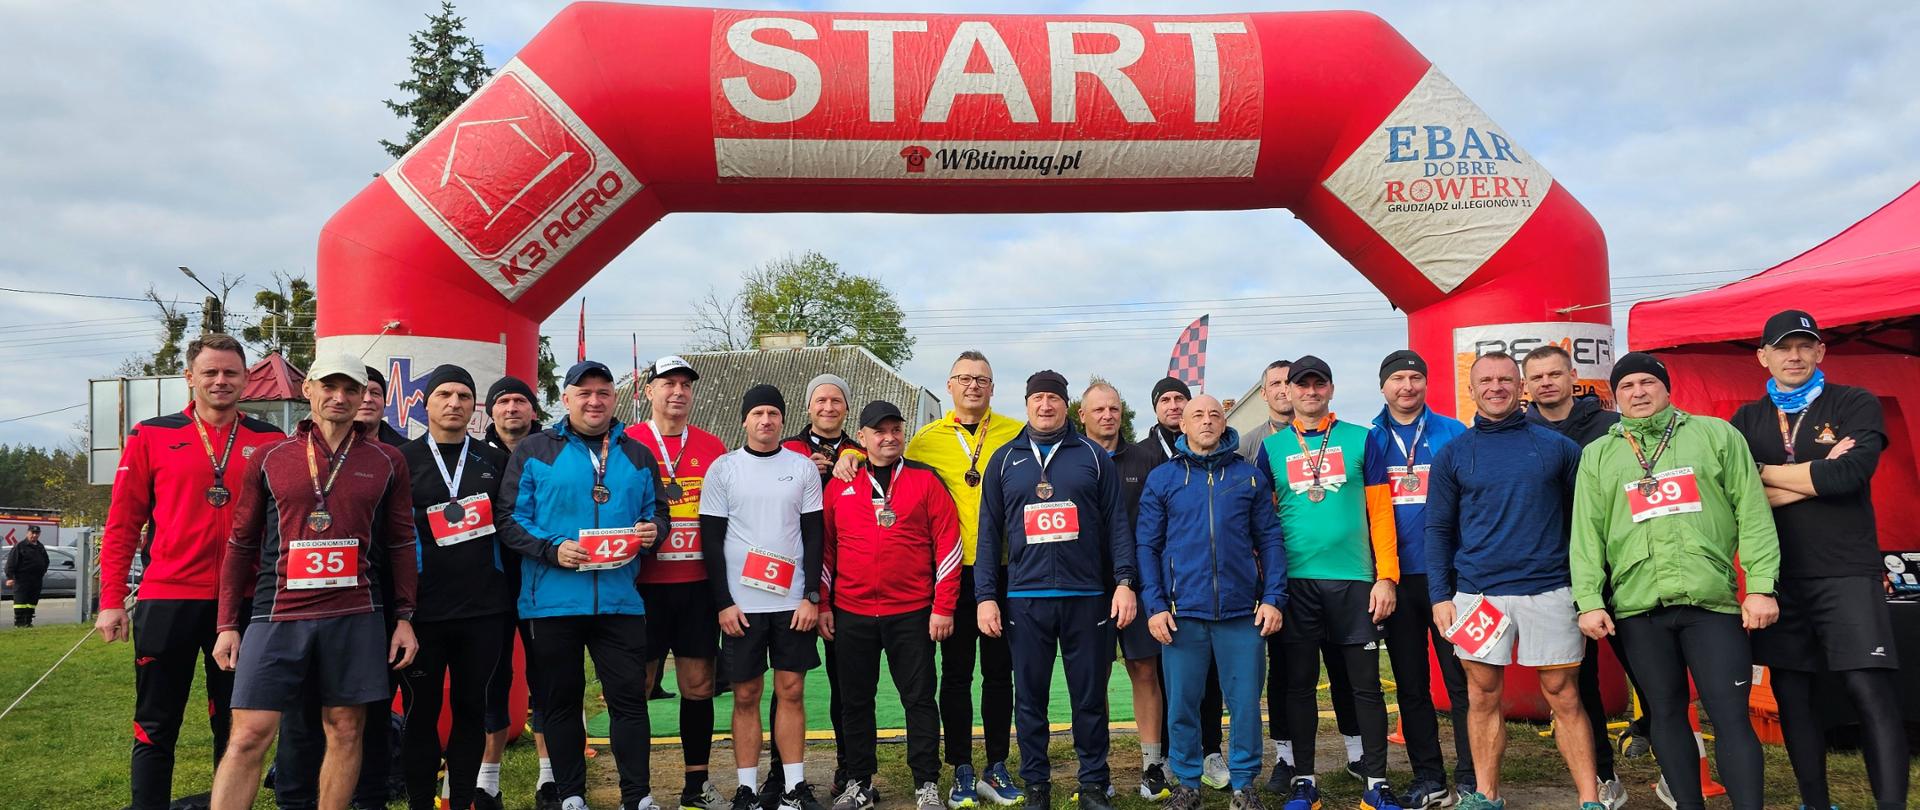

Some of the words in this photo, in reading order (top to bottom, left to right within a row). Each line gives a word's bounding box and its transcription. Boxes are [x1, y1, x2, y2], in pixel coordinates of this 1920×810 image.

[721, 18, 1247, 124] START
[1385, 125, 1522, 164] EBAR
[935, 148, 1083, 176] WBtiming.pl
[1423, 161, 1498, 177] DOBRE
[1384, 176, 1529, 203] ROWERY
[1388, 202, 1448, 213] GRUDZIĄDZ
[1522, 199, 1532, 208] 11
[498, 240, 547, 287] K3
[542, 170, 624, 249] AGRO
[1302, 458, 1331, 476] 56
[1037, 511, 1066, 531] 66
[595, 539, 628, 558] 42
[670, 531, 697, 549] 67
[305, 551, 344, 574] 35
[764, 561, 780, 580] 5
[1465, 611, 1494, 642] 54
